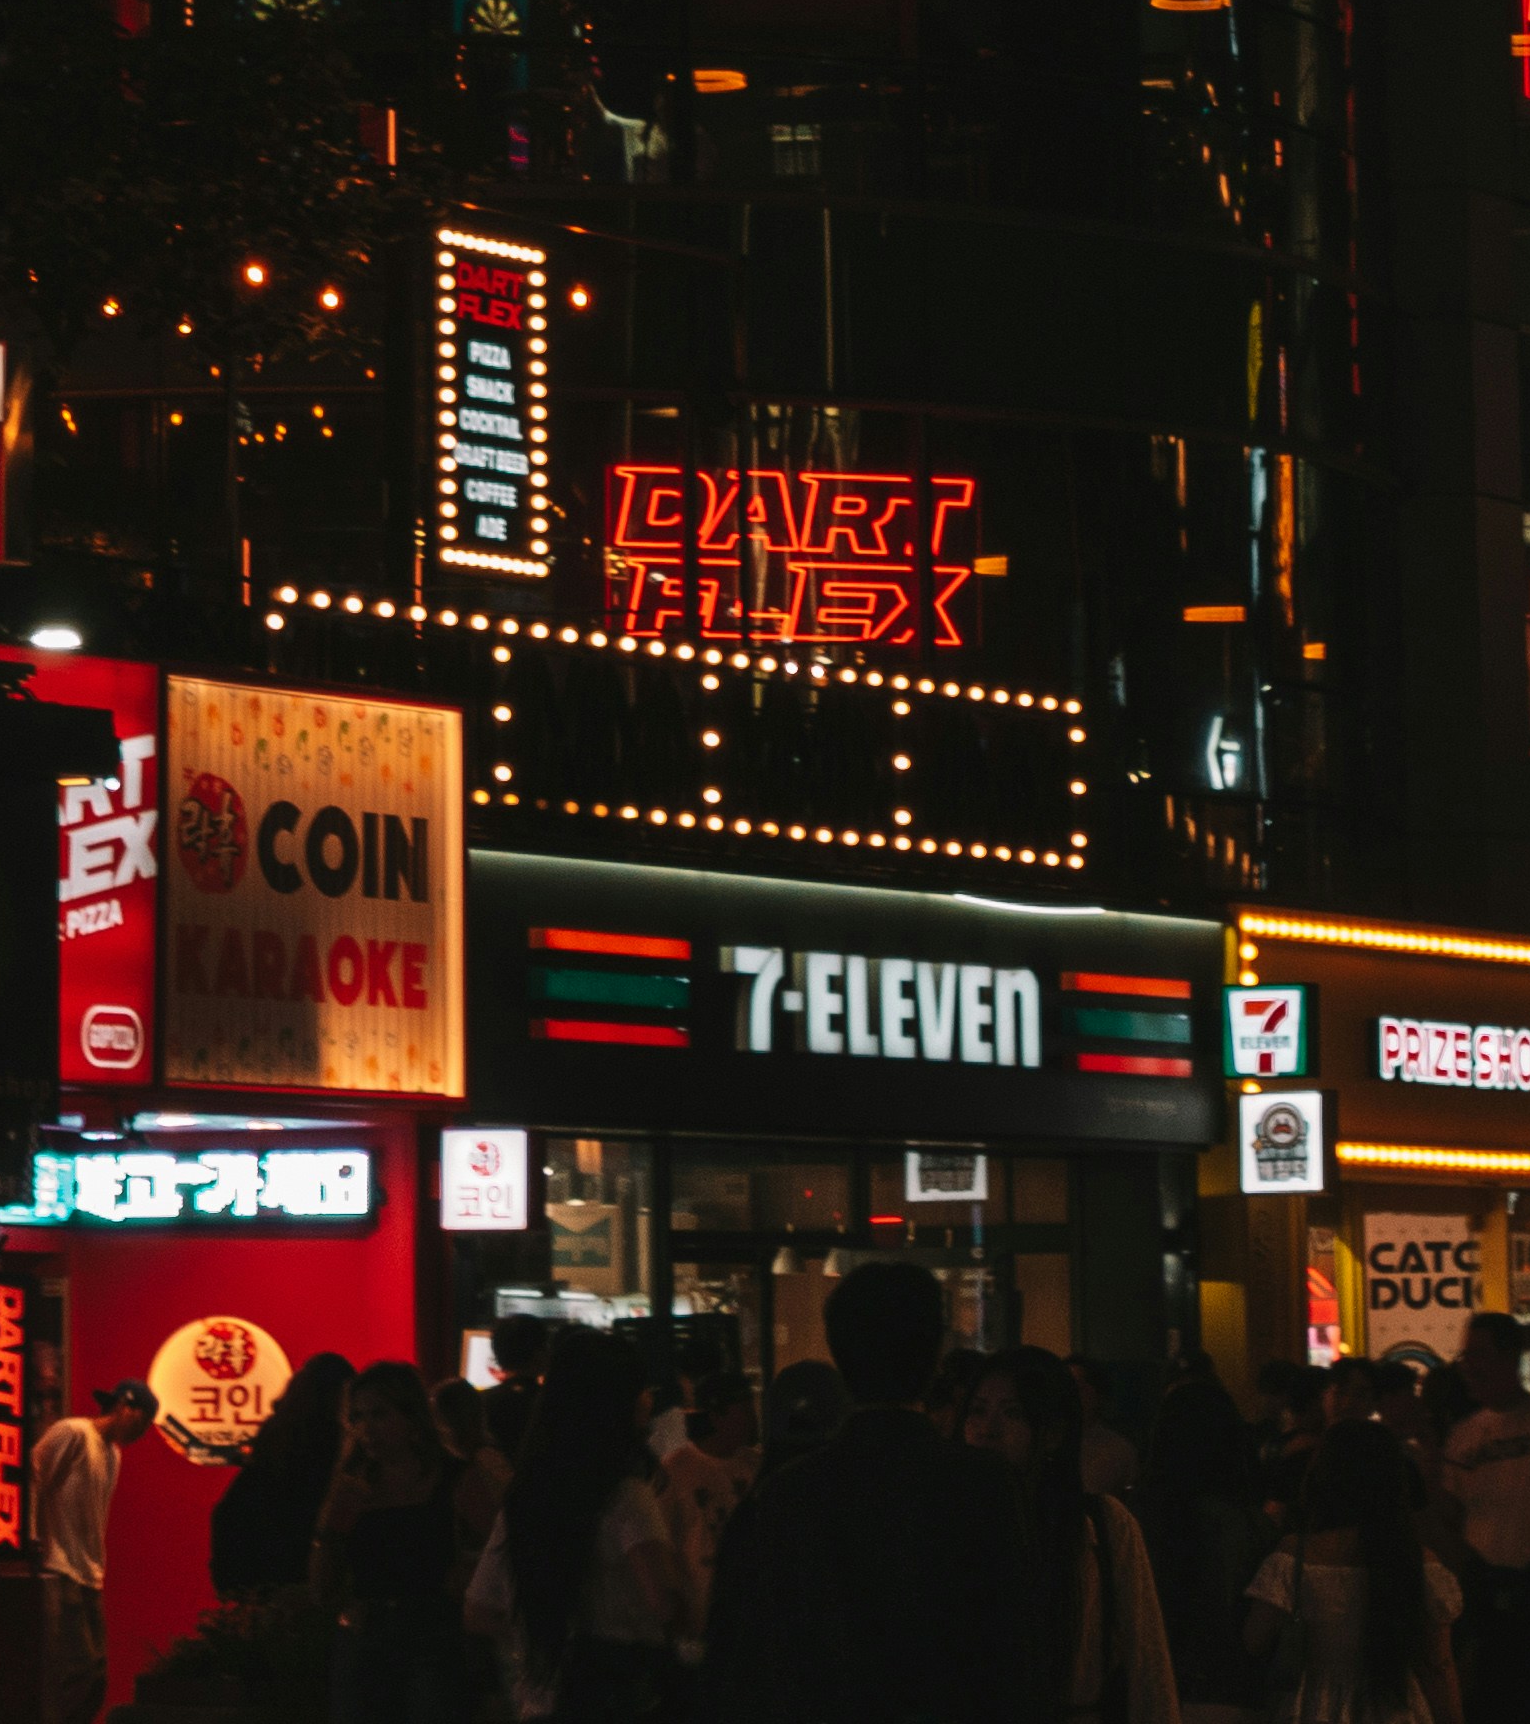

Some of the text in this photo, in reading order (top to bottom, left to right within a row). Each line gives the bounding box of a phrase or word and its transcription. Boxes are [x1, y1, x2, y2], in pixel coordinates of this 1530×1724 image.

[457, 261, 523, 299] DART
[457, 293, 523, 331] FLEX
[469, 339, 511, 369] PIZZA
[256, 800, 431, 904] COIN
[66, 899, 124, 940] PIZZA
[175, 923, 430, 1011] KARAOKE
[1380, 1017, 1472, 1087] PRIZE
[456, 1183, 515, 1220] 코인
[188, 1382, 266, 1427] 코인
